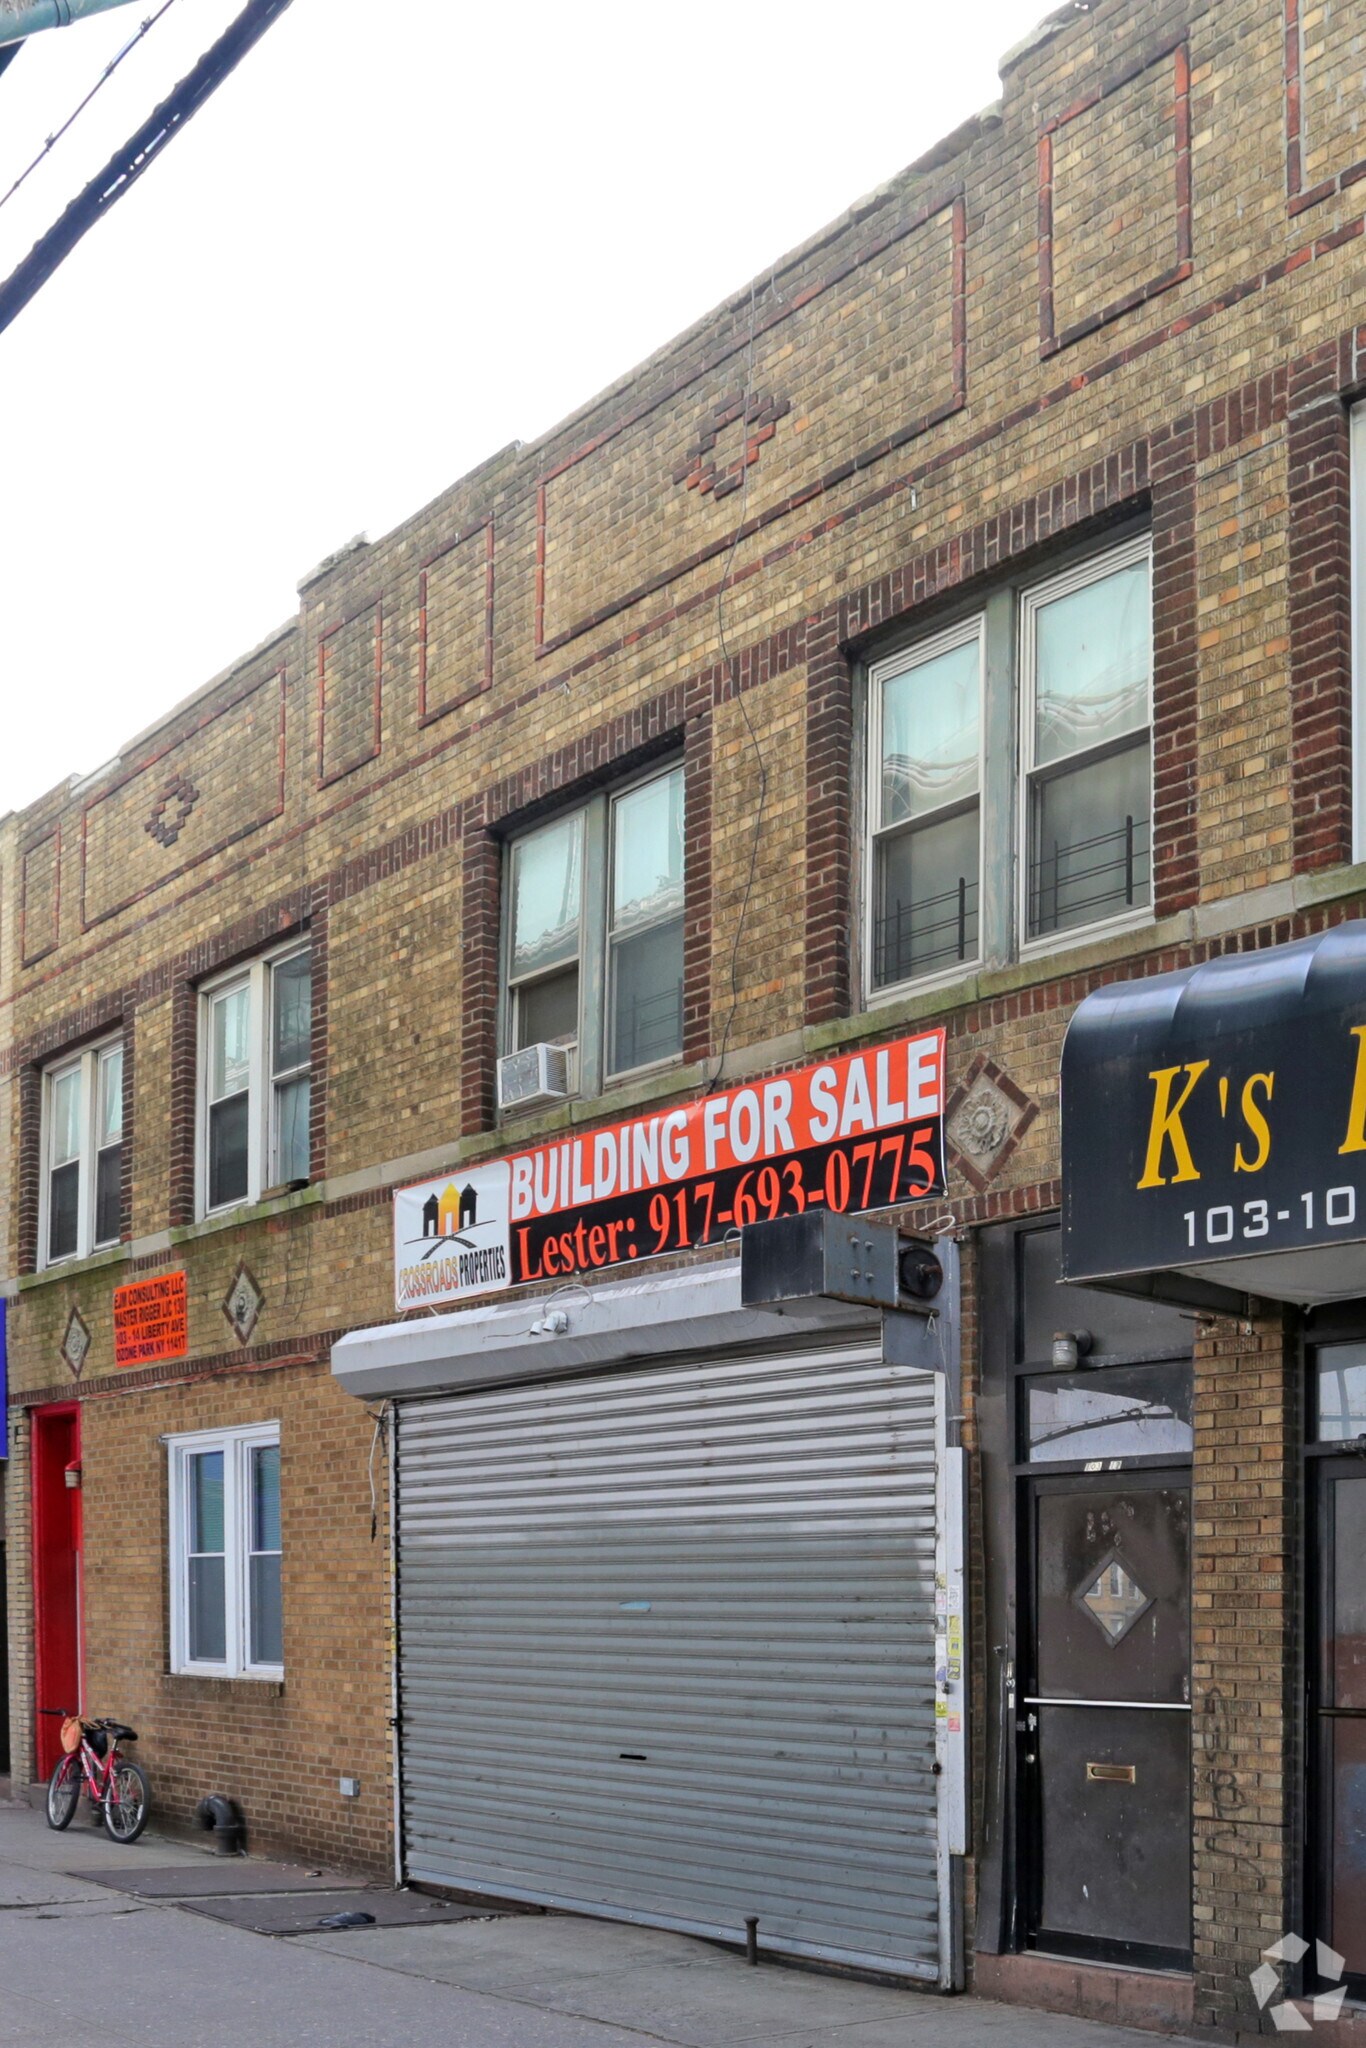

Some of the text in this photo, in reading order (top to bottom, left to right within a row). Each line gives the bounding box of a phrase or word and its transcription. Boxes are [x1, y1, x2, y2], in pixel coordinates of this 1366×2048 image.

[511, 1035, 938, 1219] BUILDING FOR SALE
[517, 1127, 936, 1281] Lester: 917-693-0775
[1183, 1185, 1355, 1247] 103-10
[460, 1245, 505, 1286] PROPERTIES
[128, 1280, 169, 1306] CONSULTING
[171, 1276, 184, 1295] LLC
[115, 1308, 137, 1329] MASTER
[138, 1302, 160, 1323] RIGGER
[162, 1299, 172, 1318] LIC
[141, 1321, 169, 1340] LIBERTY
[171, 1317, 184, 1334] AVE
[116, 1345, 137, 1361] OZONE
[138, 1341, 155, 1359] PARK
[156, 1339, 164, 1354] NY
